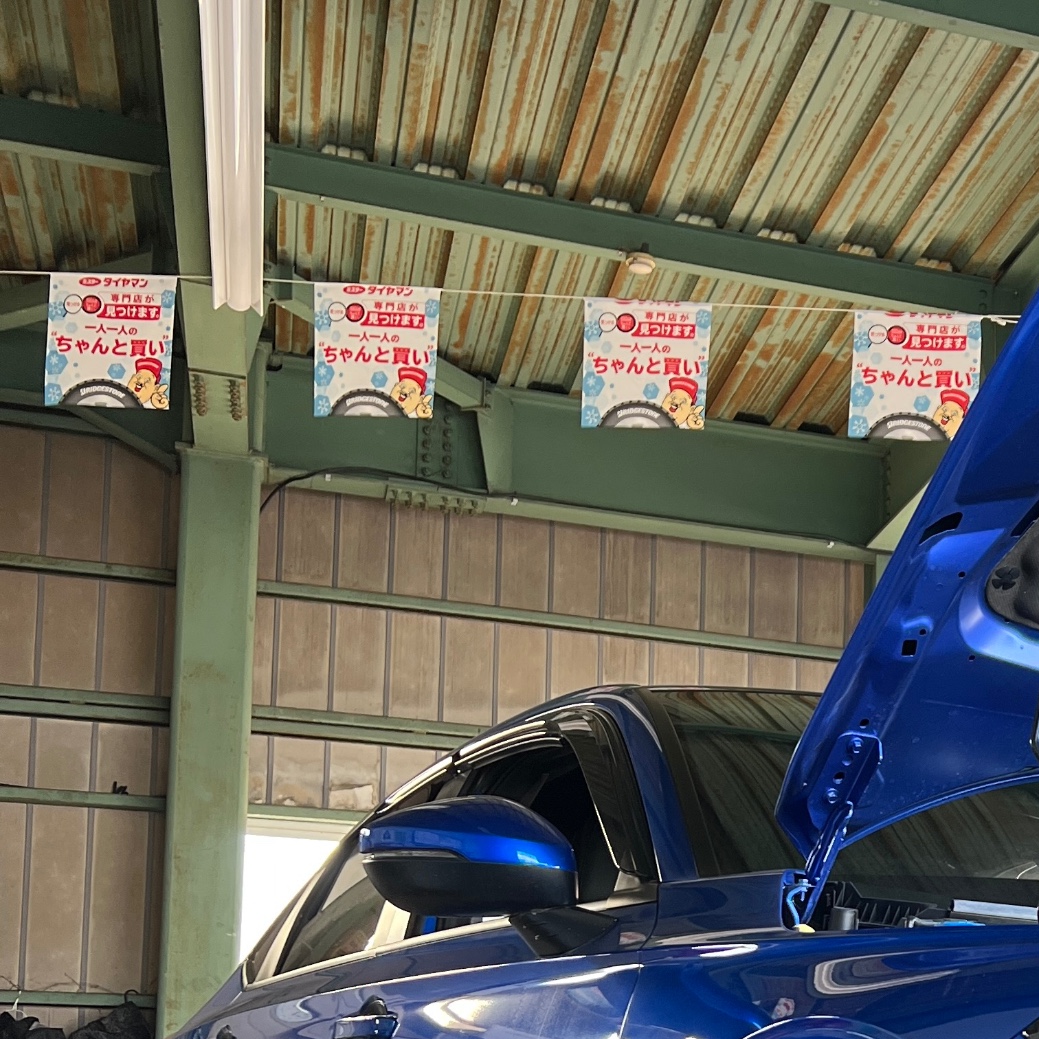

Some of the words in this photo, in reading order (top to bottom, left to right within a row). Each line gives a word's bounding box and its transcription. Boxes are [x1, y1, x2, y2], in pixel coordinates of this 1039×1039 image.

[103, 277, 148, 288] タイヤマン
[367, 285, 413, 297] タイヤマン
[111, 293, 155, 303] 専門店が
[373, 301, 419, 312] 専門店が
[645, 311, 689, 322] 専門店が
[84, 323, 138, 336] 一人一人の
[916, 324, 961, 335] 専門店が
[348, 331, 400, 343] 一人一人の
[619, 342, 671, 354] 一人一人の
[890, 354, 943, 367] 一人一人の
